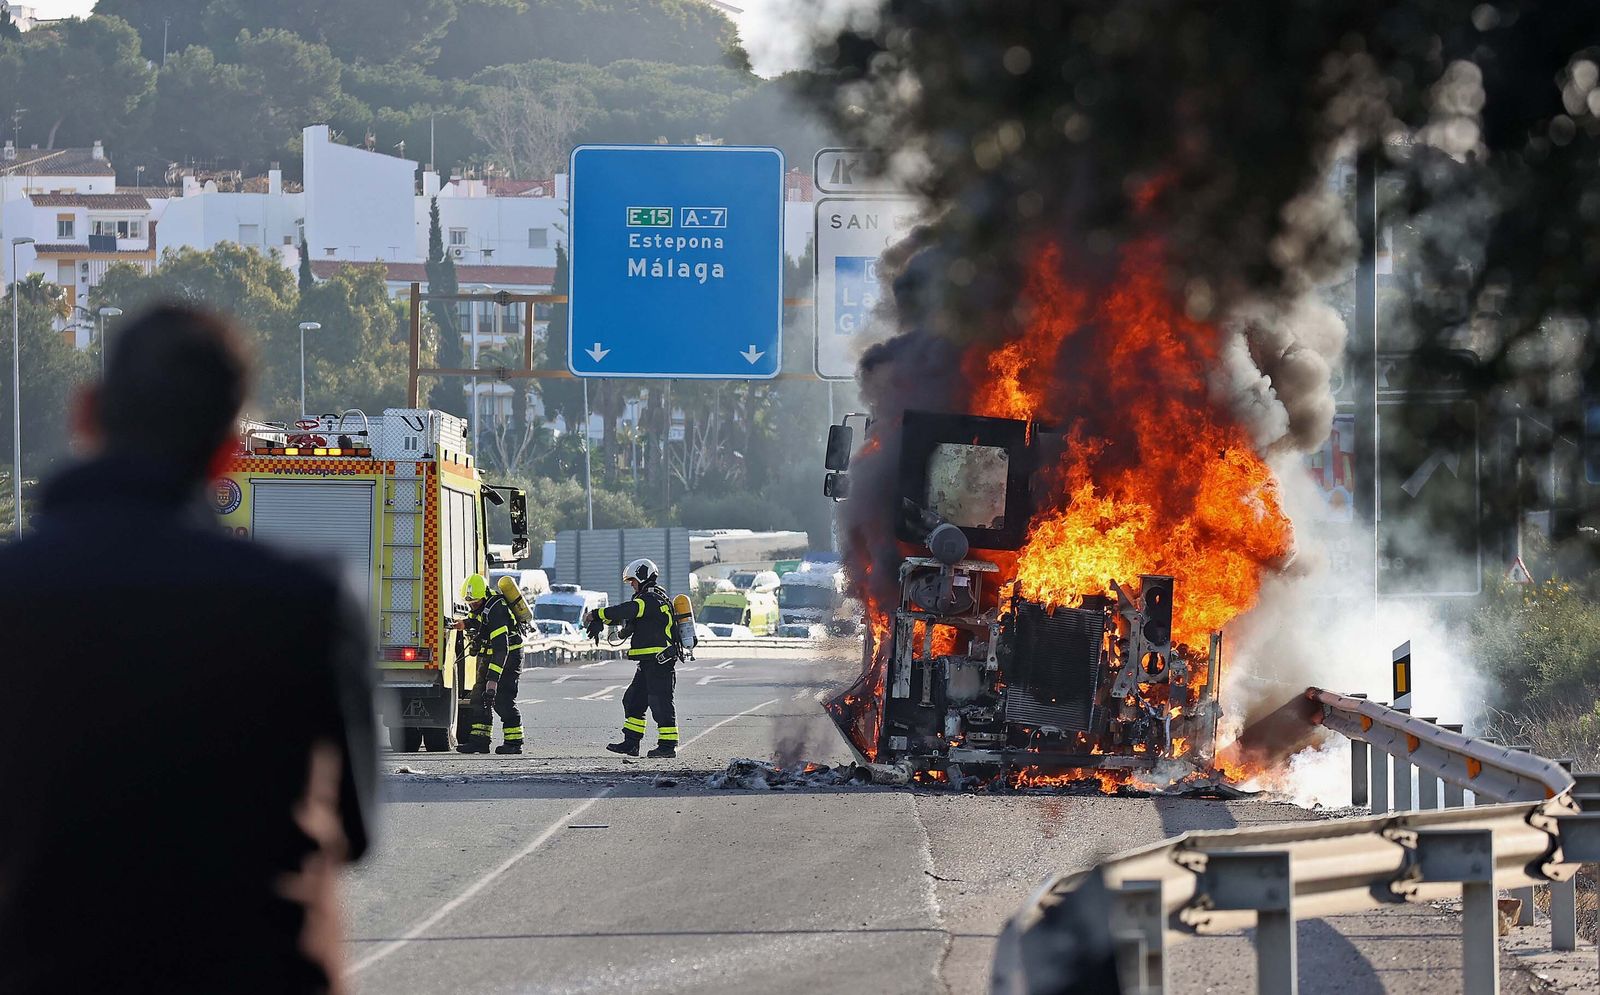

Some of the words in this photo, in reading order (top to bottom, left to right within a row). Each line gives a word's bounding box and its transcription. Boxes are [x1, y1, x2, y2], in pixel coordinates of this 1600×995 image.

[629, 209, 670, 225] E-15
[684, 210, 724, 226] A-7
[830, 214, 878, 230] SAN
[629, 233, 724, 252] Estepona
[628, 257, 724, 284] Málaga
